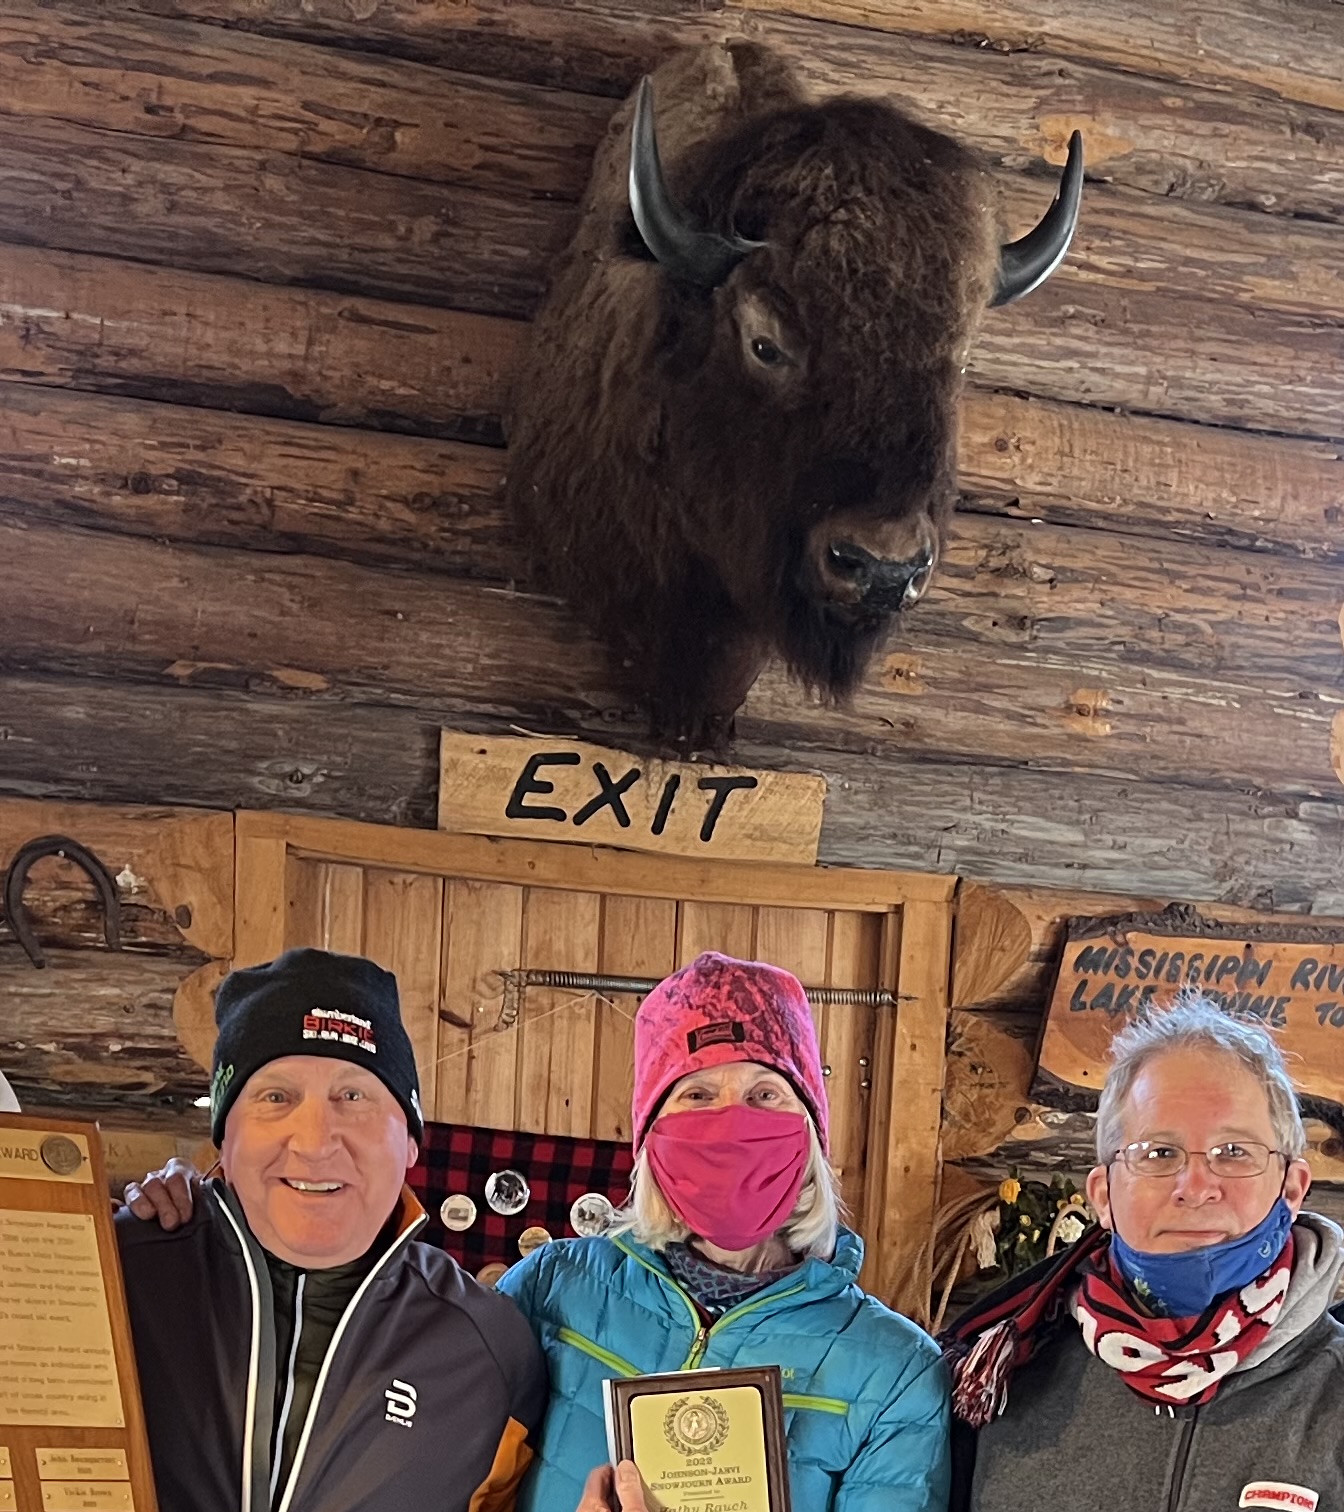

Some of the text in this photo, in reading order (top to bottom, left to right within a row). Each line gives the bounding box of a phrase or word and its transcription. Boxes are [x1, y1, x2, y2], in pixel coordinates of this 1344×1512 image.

[505, 752, 758, 842] EXIT
[1073, 945, 1273, 989] MISSISSIPPI
[1070, 979, 1157, 1021] LAKE
[303, 1015, 375, 1043] BIRKIE
[715, 1475, 752, 1487] AWARD
